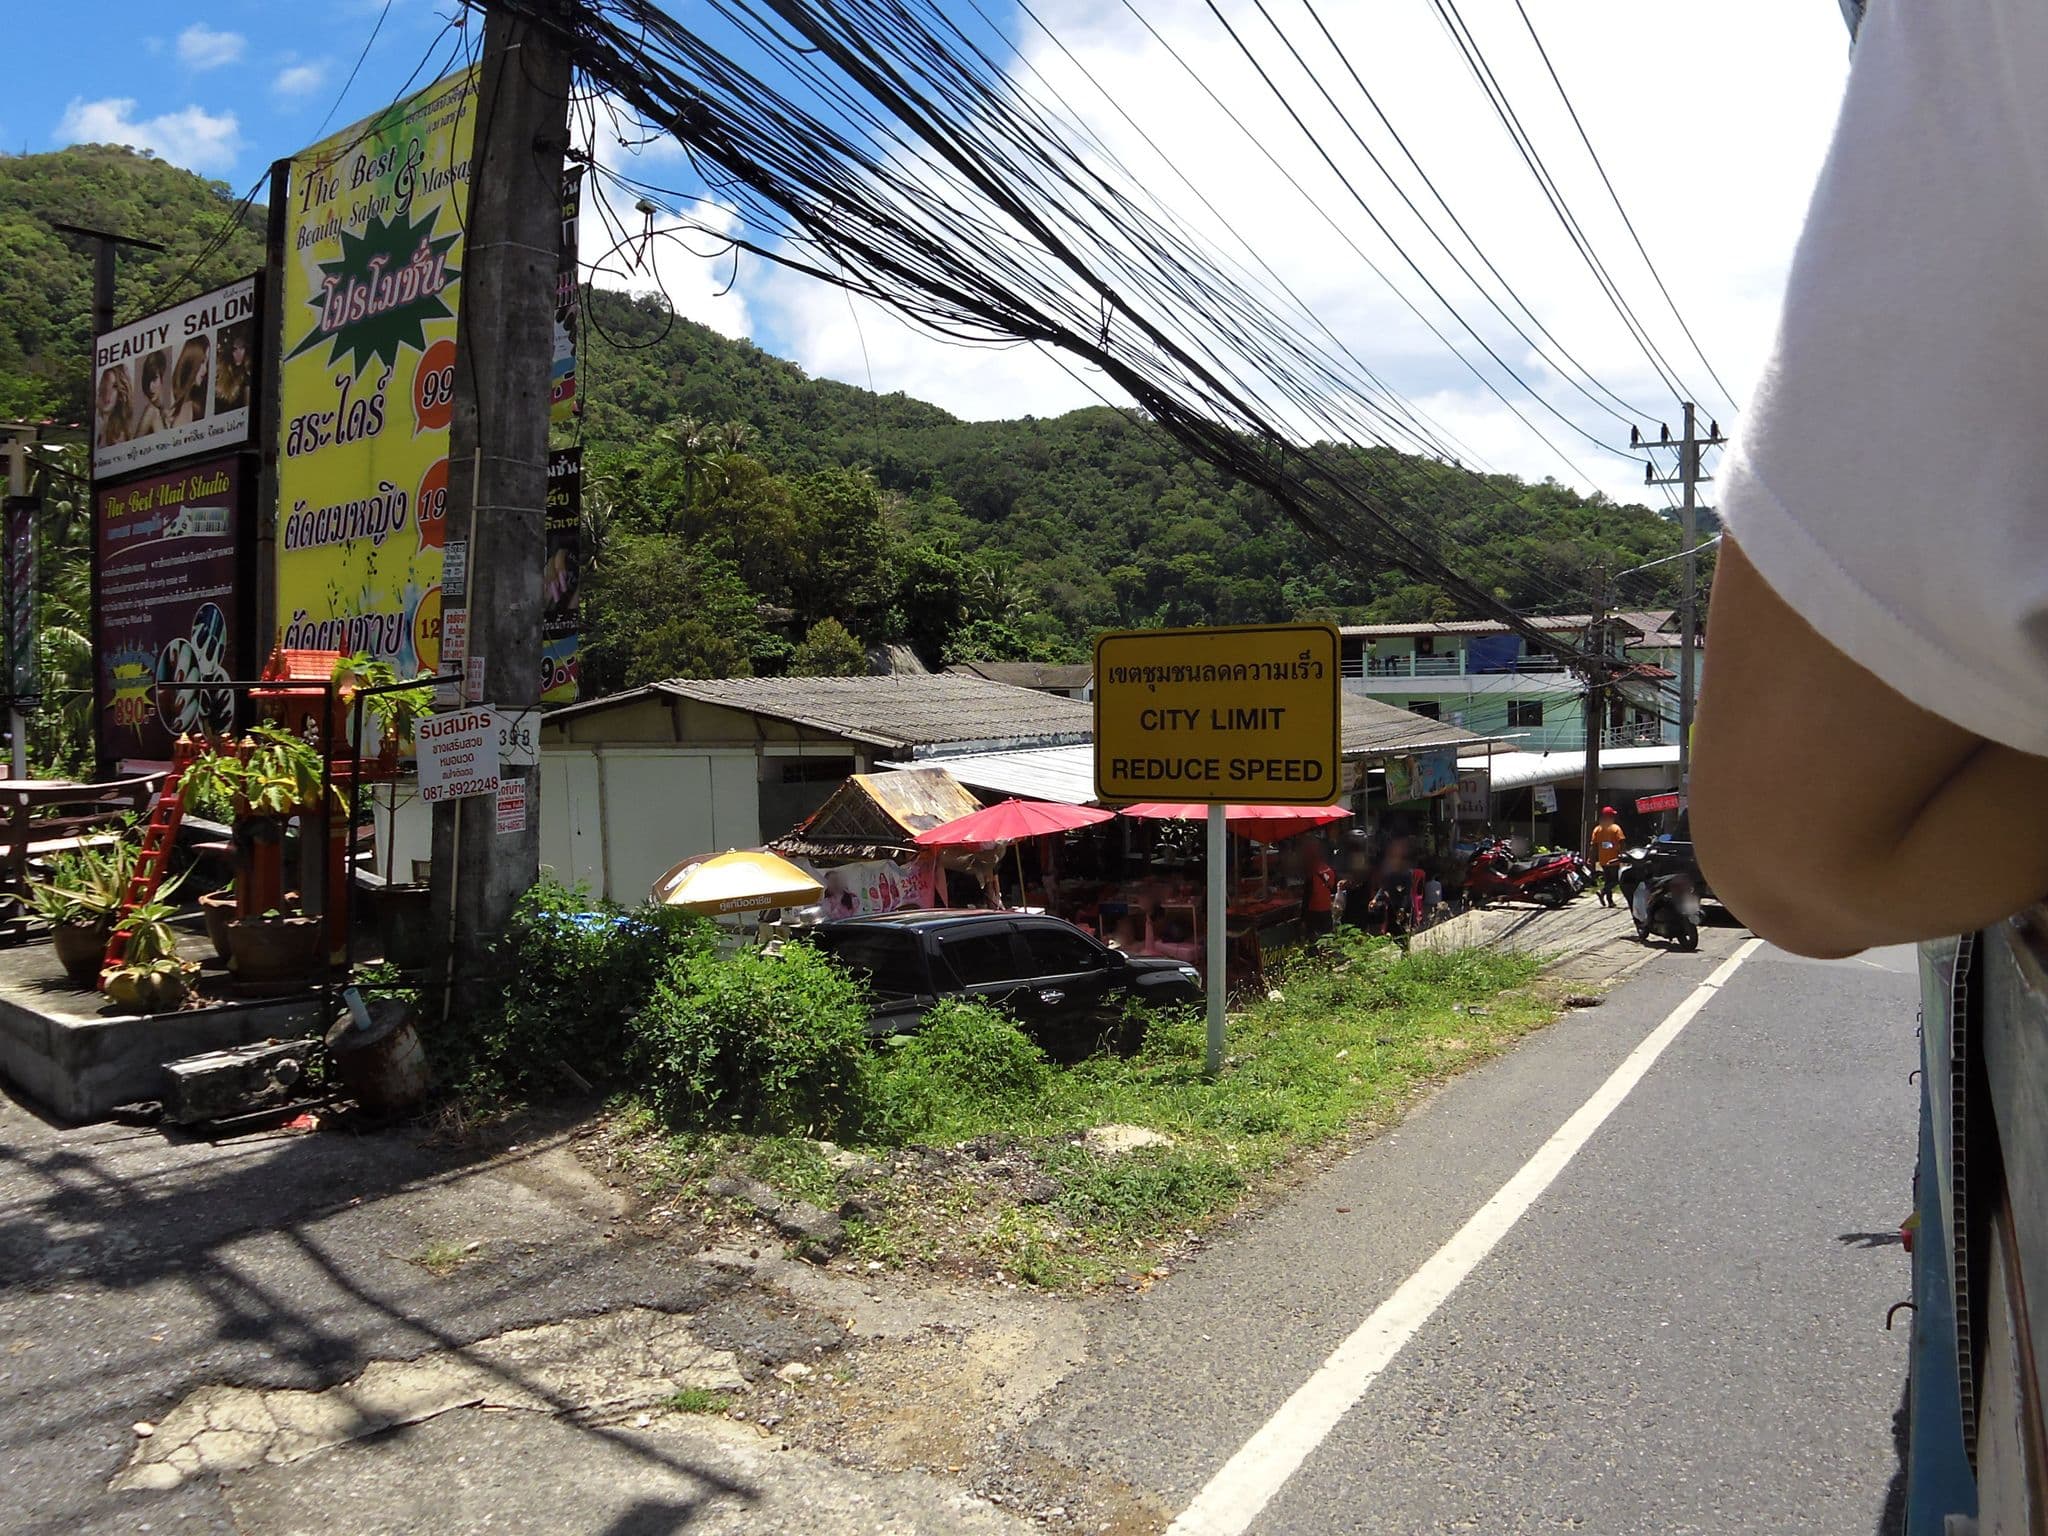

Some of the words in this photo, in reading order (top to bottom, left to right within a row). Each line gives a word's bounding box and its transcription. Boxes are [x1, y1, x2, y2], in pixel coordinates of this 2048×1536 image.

[296, 216, 342, 250] Beauty
[350, 194, 390, 228] Salon
[394, 138, 425, 215] &
[419, 159, 474, 197] Massag
[300, 171, 340, 214] The
[350, 147, 397, 191] Best
[321, 238, 447, 333] โปรโมชั่น
[98, 323, 170, 368] BEAUTY
[184, 292, 254, 336] SALON
[286, 365, 392, 458] สระไดร์
[128, 488, 154, 513] Best
[189, 471, 230, 501] Studio
[284, 480, 409, 549] ตัดผมหญิง
[418, 488, 448, 522] 19
[421, 618, 441, 640] 12
[1108, 649, 1324, 693] เขตชุมชนลดความเร็ว
[420, 712, 491, 740] รับสมัคร
[1140, 709, 1200, 731] CITY
[1211, 707, 1286, 730] LIMIT
[432, 737, 483, 754] ช่างเสริมสวย
[439, 753, 475, 767] หมอนวด
[423, 776, 499, 801] 087-8922248
[1112, 758, 1220, 780] REDUCE
[1228, 758, 1323, 782] SPEED
